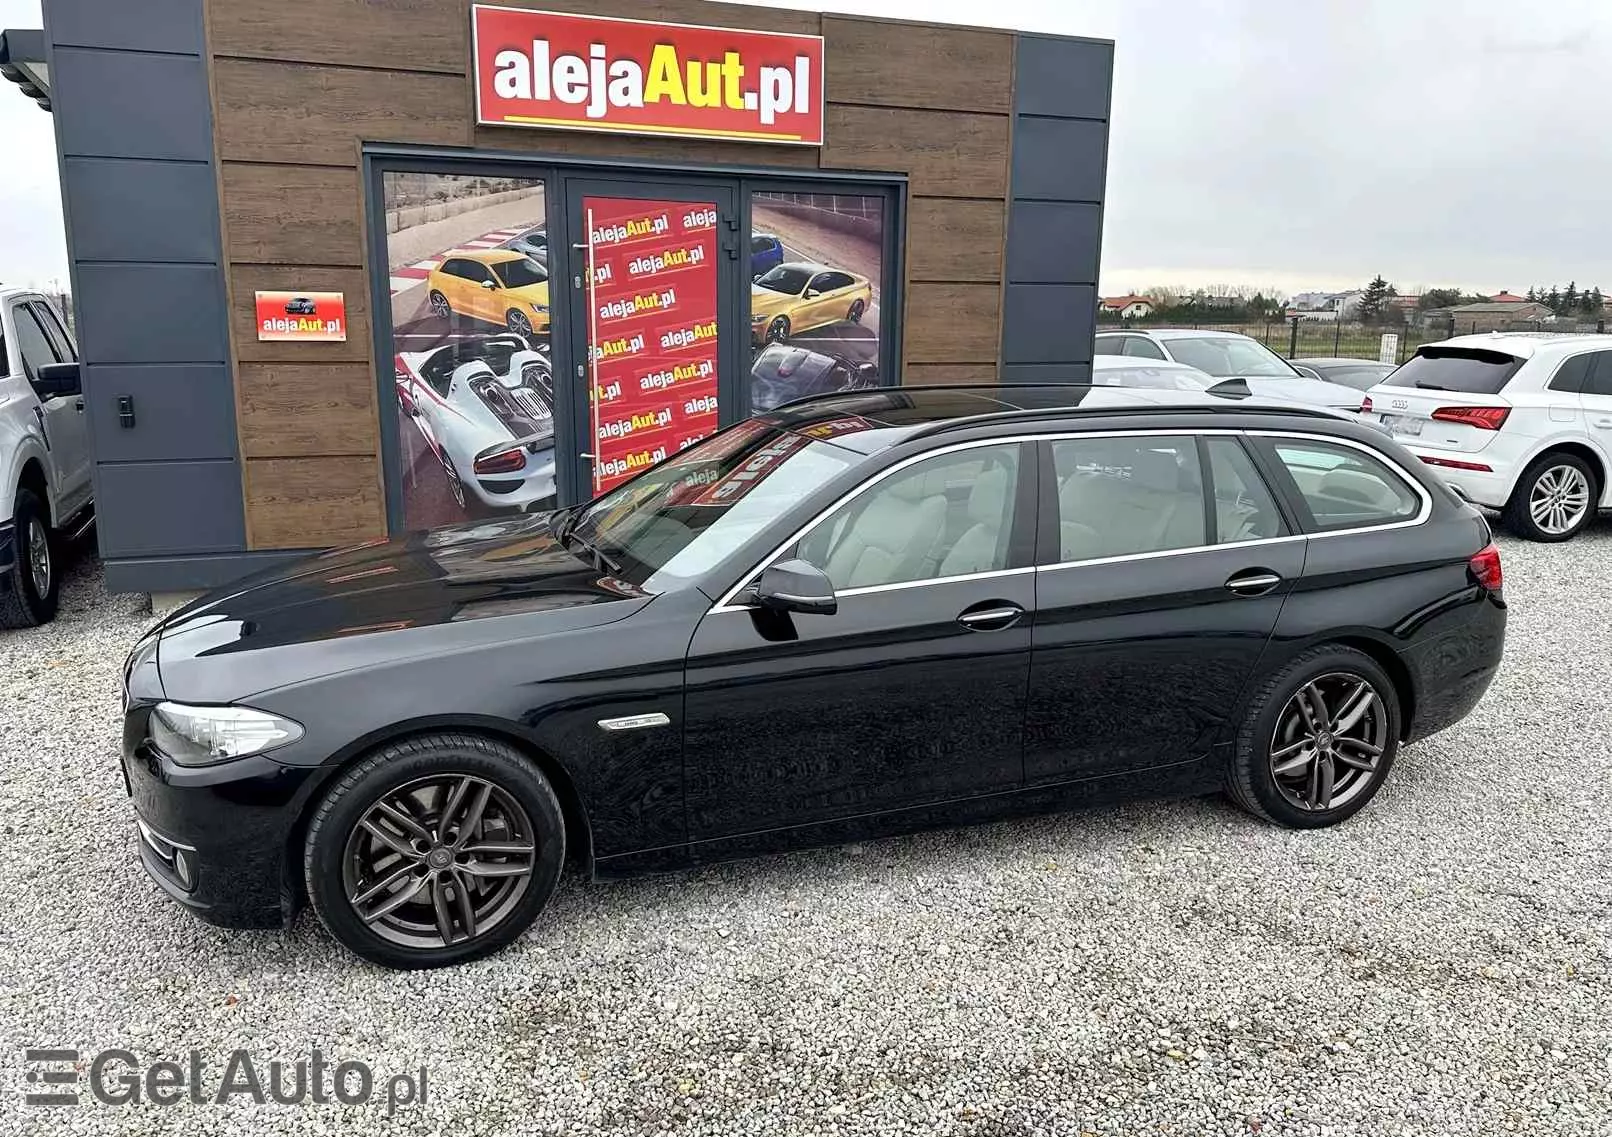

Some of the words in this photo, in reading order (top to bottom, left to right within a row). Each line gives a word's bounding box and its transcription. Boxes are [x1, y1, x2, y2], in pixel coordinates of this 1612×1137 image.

[494, 39, 809, 125] alejaAut.pl
[592, 214, 669, 243] alejaAut.pl
[629, 246, 705, 275] alejaAut.pl
[600, 289, 676, 319] alejaAut.pl
[263, 317, 340, 333] alejaAut.pl
[640, 360, 713, 389] alejaAut.pl
[684, 396, 718, 413] aleja
[599, 408, 672, 438] alejaAut.pl
